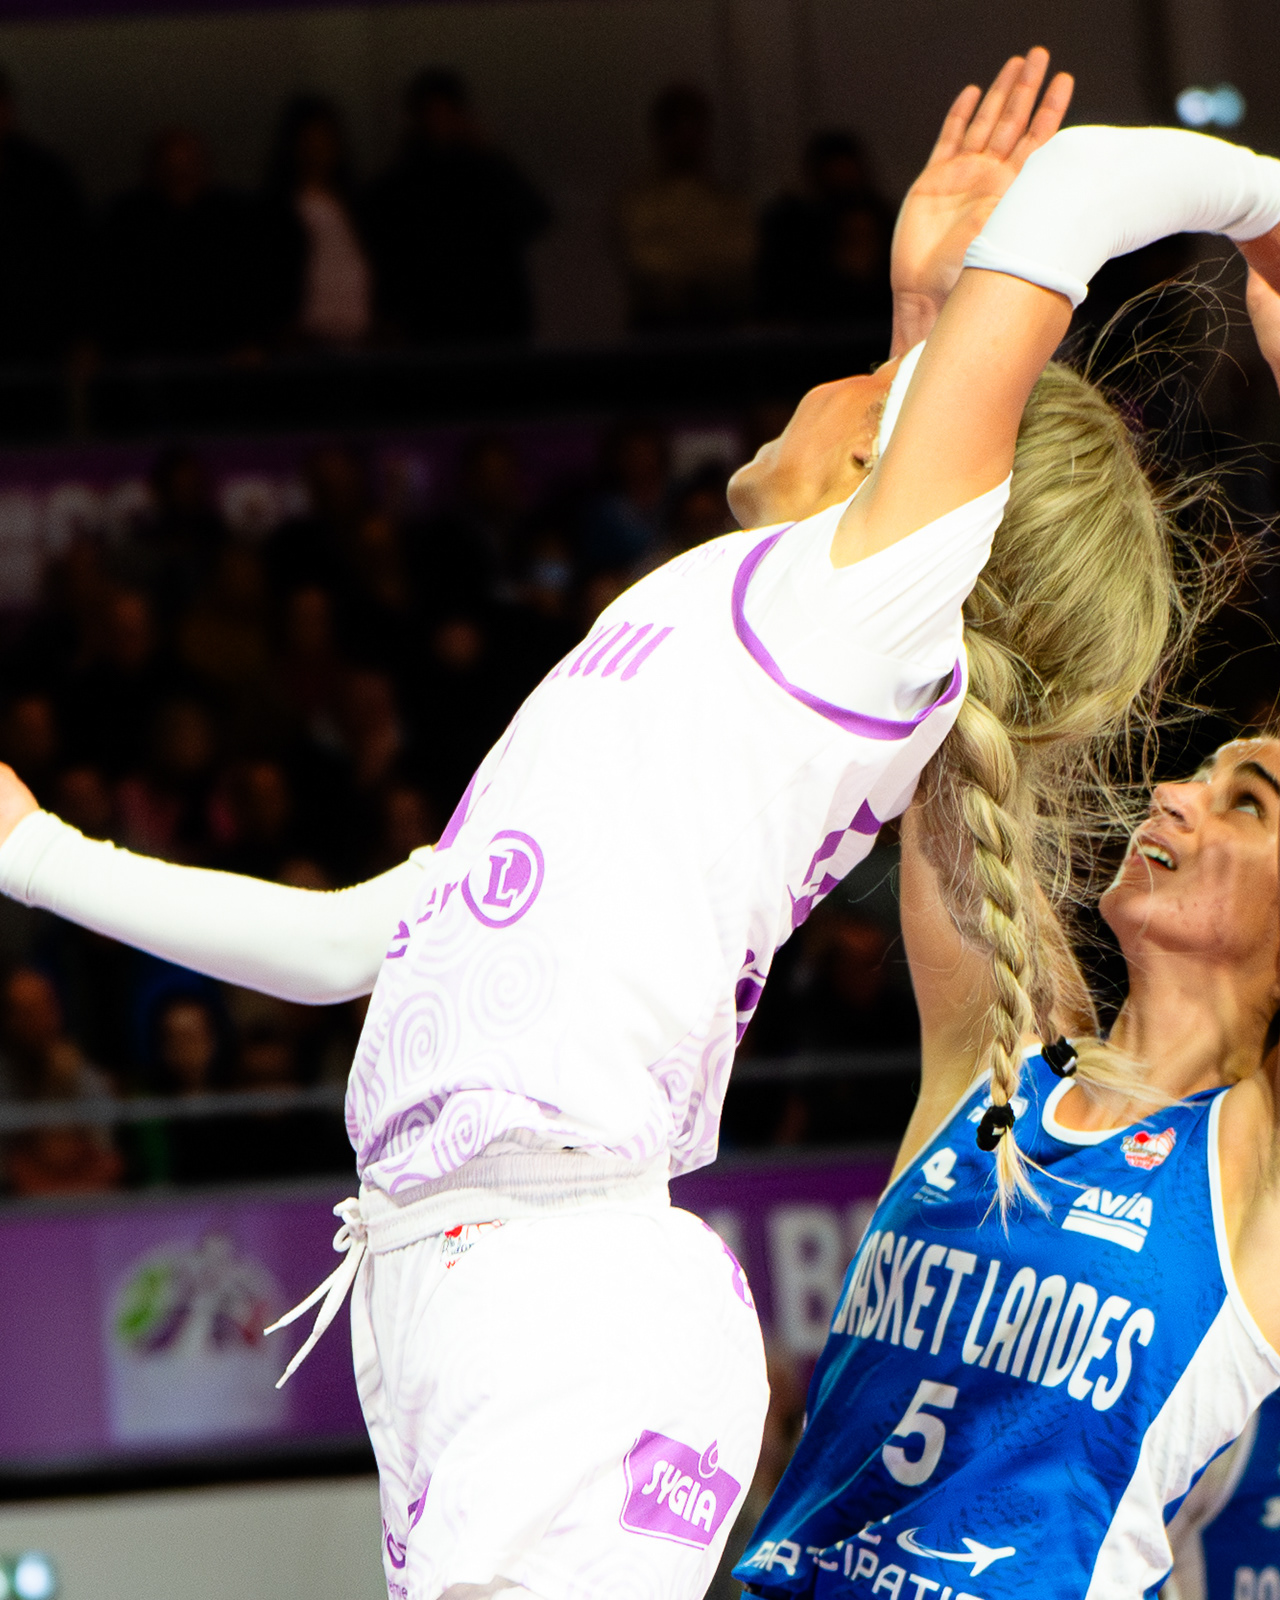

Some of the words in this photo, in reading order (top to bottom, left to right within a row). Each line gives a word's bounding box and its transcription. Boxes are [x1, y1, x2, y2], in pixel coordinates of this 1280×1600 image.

[962, 1259, 1156, 1412] LANDES
[881, 1378, 959, 1488] 5
[641, 1460, 718, 1533] SYGIA
